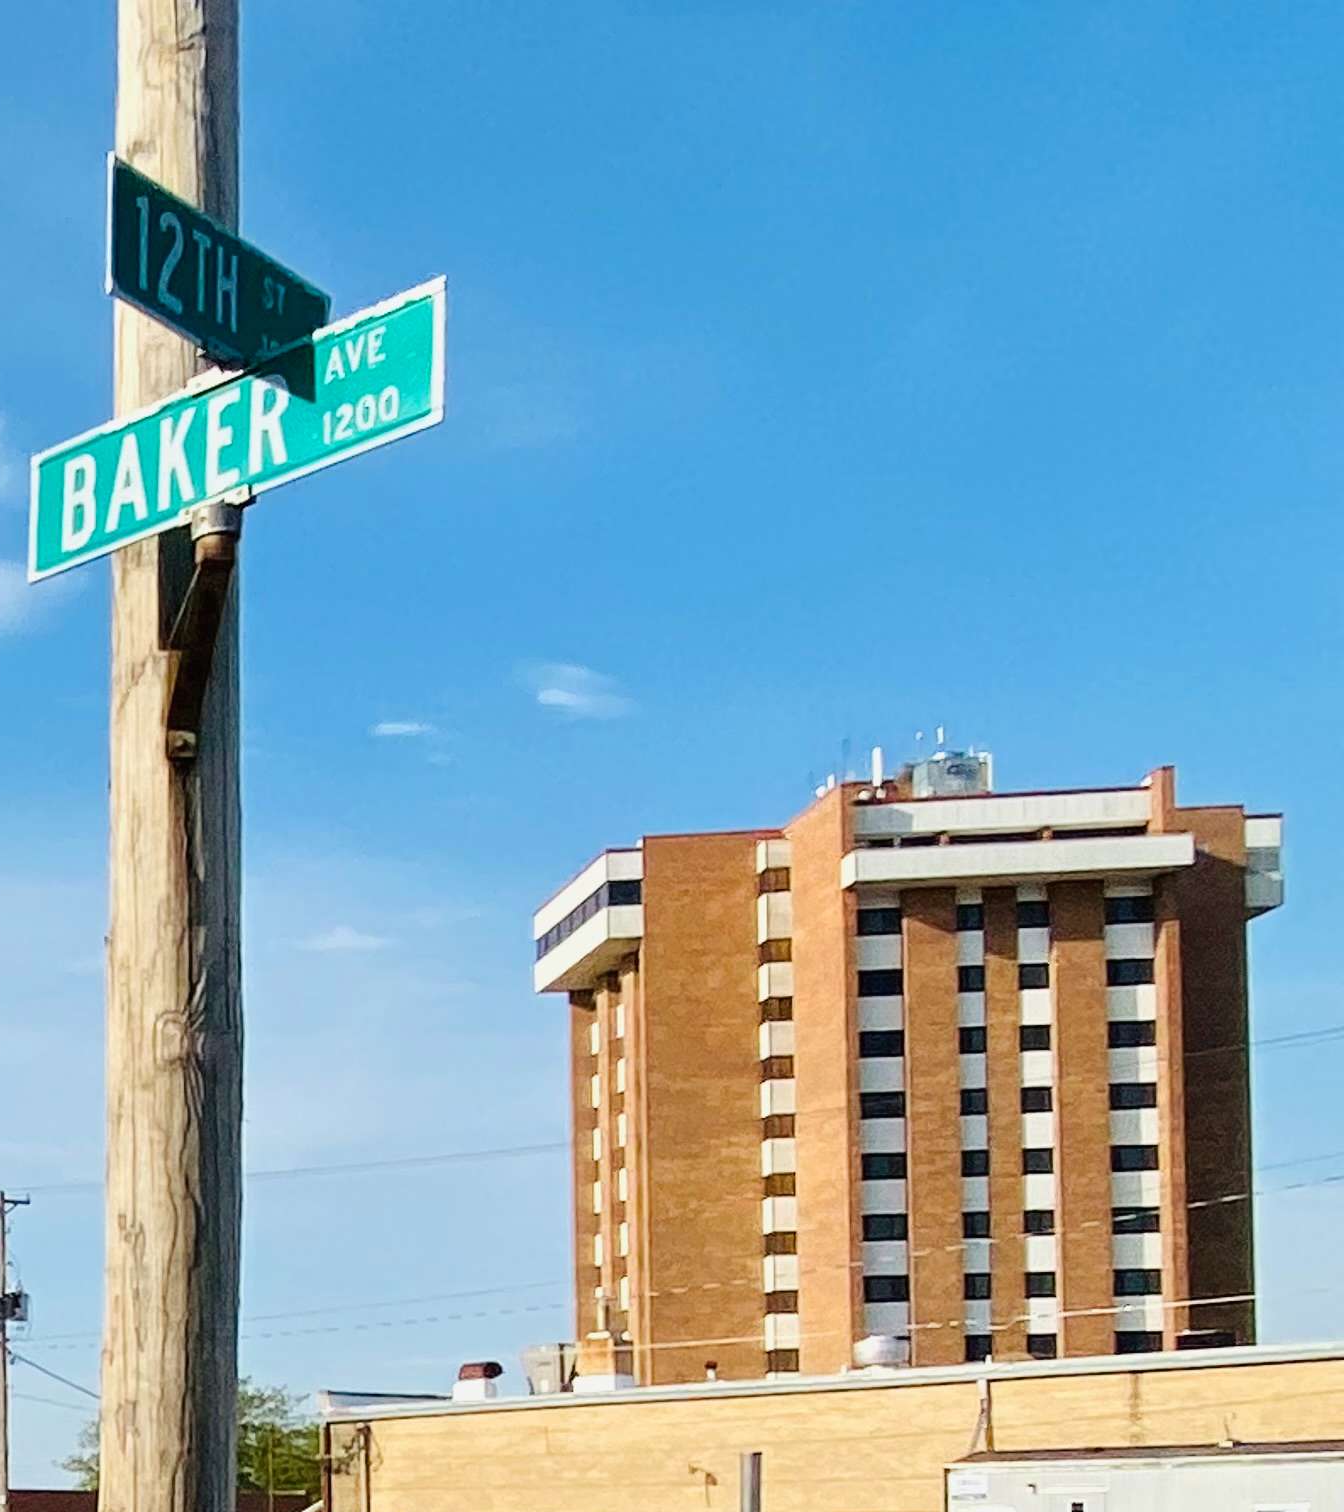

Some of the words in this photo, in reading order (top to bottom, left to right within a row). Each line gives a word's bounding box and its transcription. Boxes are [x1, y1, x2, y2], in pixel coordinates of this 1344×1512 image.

[135, 196, 239, 333] 12TH
[263, 276, 287, 316] ST
[61, 374, 291, 553] BAKER
[324, 325, 387, 385] AVE
[322, 385, 400, 447] 1200
